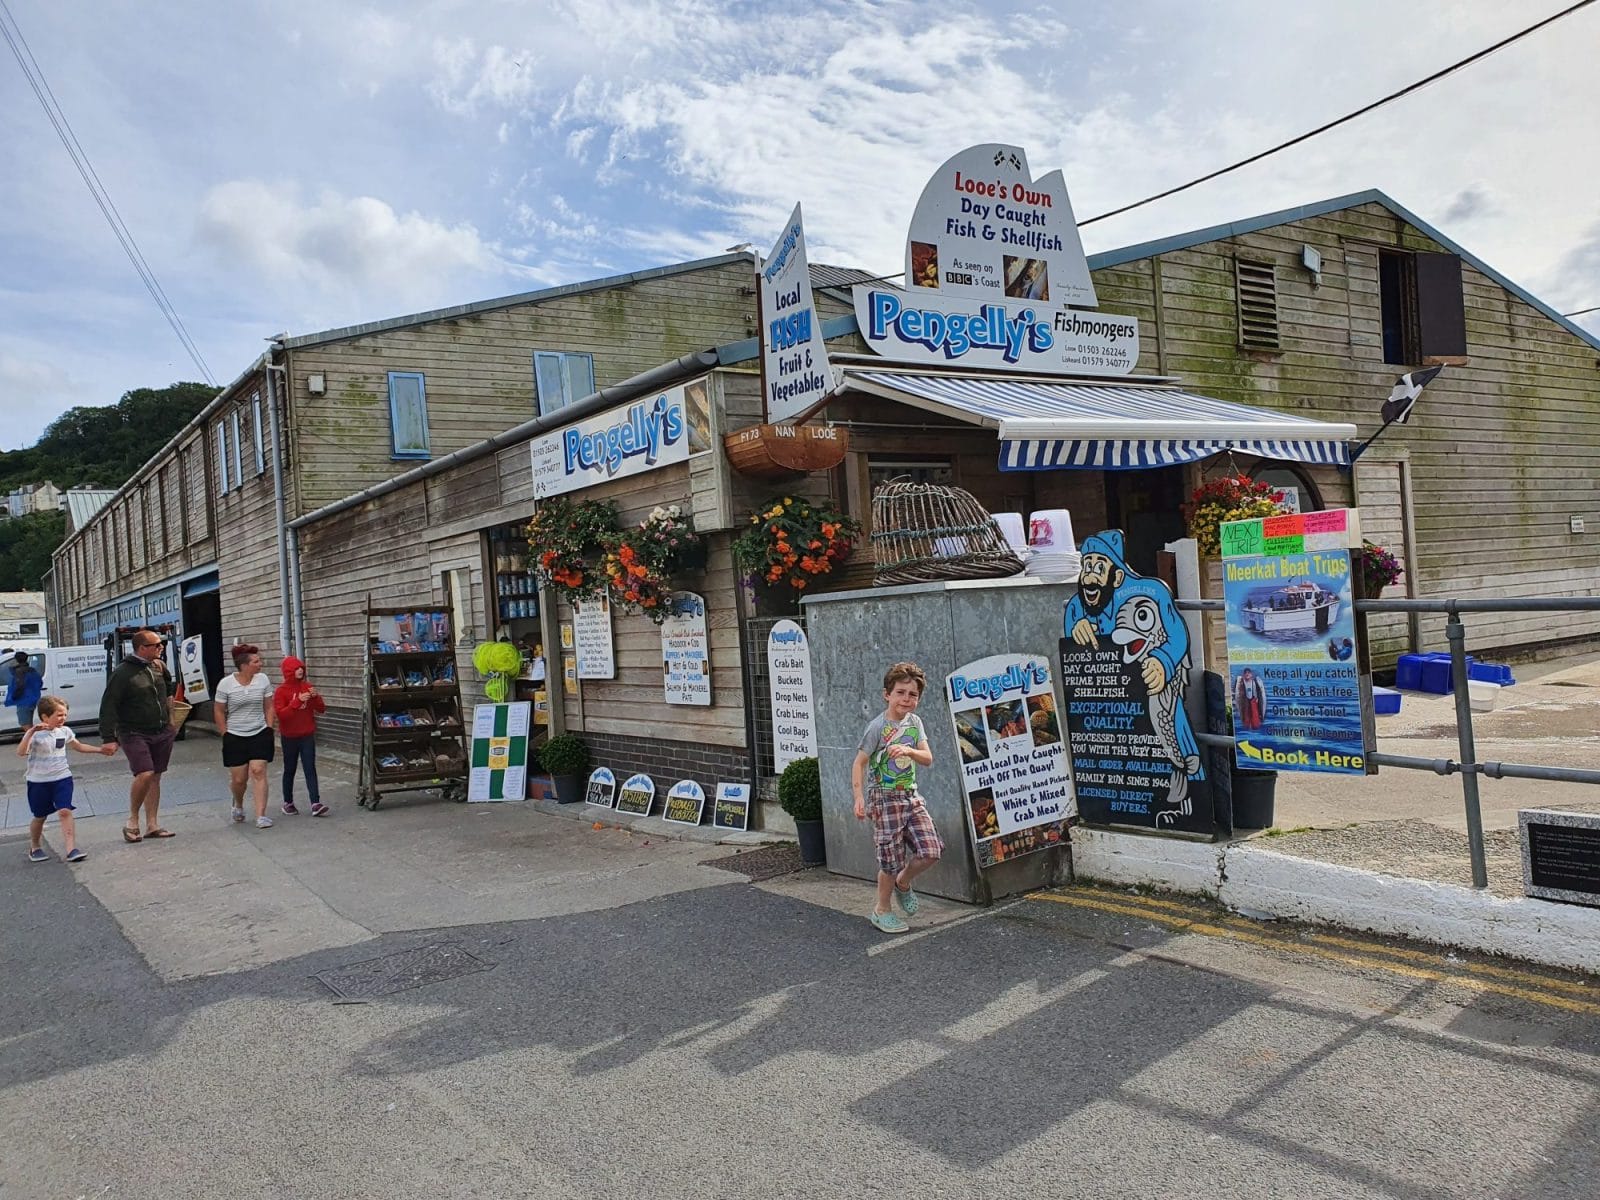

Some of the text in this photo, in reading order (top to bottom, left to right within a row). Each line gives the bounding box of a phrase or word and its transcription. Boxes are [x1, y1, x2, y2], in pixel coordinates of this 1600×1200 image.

[955, 172, 1052, 207] Looe's Own
[961, 198, 1046, 226] Day Caught
[946, 218, 1062, 251] Fish & Shellfish
[953, 258, 994, 274] As seen on
[981, 276, 1000, 288] Coast
[776, 282, 801, 311] Local
[770, 308, 812, 352] FISH
[868, 290, 1054, 364] Pengelly's
[1055, 312, 1134, 342] Fishmongers
[1078, 345, 1100, 354] 01503
[1102, 347, 1126, 357] 262246
[780, 349, 813, 375] Fruit &
[1082, 356, 1103, 366] 01579
[1106, 359, 1130, 368] 340777
[771, 374, 825, 403] Vegetables
[562, 394, 684, 477] Pengelly's
[776, 426, 796, 438] NAN
[812, 428, 836, 440] LOOE
[1223, 522, 1260, 539] NEXT
[1227, 538, 1260, 554] TRIP
[1227, 554, 1348, 581] Meerkat Boat Trips
[1064, 650, 1118, 662] LOOE'S OWN
[774, 659, 804, 669] Crab Bait
[1064, 664, 1121, 674] DAY CAUGHT
[778, 676, 803, 686] Buckets
[950, 661, 1048, 702] Pengelly's
[1066, 676, 1130, 686] PRIME FISH &
[1264, 668, 1356, 681] Keep all you catch!
[776, 692, 808, 702] Drop Nets
[1074, 688, 1128, 697] SHELLFISH.
[1273, 686, 1352, 696] Rods & Bait free
[776, 708, 809, 720] Crab Lines
[1070, 702, 1144, 714] EXCEPTIONAL
[1318, 706, 1346, 717] Toilet
[1084, 716, 1134, 730] QUALITY.
[778, 725, 809, 738] Cool Bags
[1266, 726, 1354, 738] Children Welcome
[1071, 733, 1115, 742] PROCESSED
[1129, 736, 1161, 745] PROVIDE
[780, 742, 808, 754] Ice Packs
[1072, 744, 1086, 754] YOU
[1089, 745, 1109, 754] WITH
[1112, 746, 1128, 756] THE
[1130, 748, 1150, 757] VERY
[966, 746, 1061, 776] Fresh Local Day Caught
[1074, 758, 1096, 768] MAIL
[1099, 760, 1123, 770] ORDER
[1262, 748, 1363, 768] Book Here
[978, 774, 994, 787] Fish
[1012, 766, 1027, 779] The
[1030, 760, 1055, 773] Quay!
[1076, 772, 1105, 782] FAMILY
[1108, 774, 1124, 785] RUN
[1127, 776, 1150, 786] SINCE
[1010, 783, 1030, 795] Quality
[1033, 778, 1048, 789] Hand
[1050, 774, 1070, 784] Picked
[1002, 787, 1066, 811] White & Mixed
[1078, 788, 1154, 802] LICENSED DIRECT
[1014, 809, 1034, 822] Crab
[1037, 803, 1059, 816] Meat
[1111, 802, 1150, 814] BUYERS.
